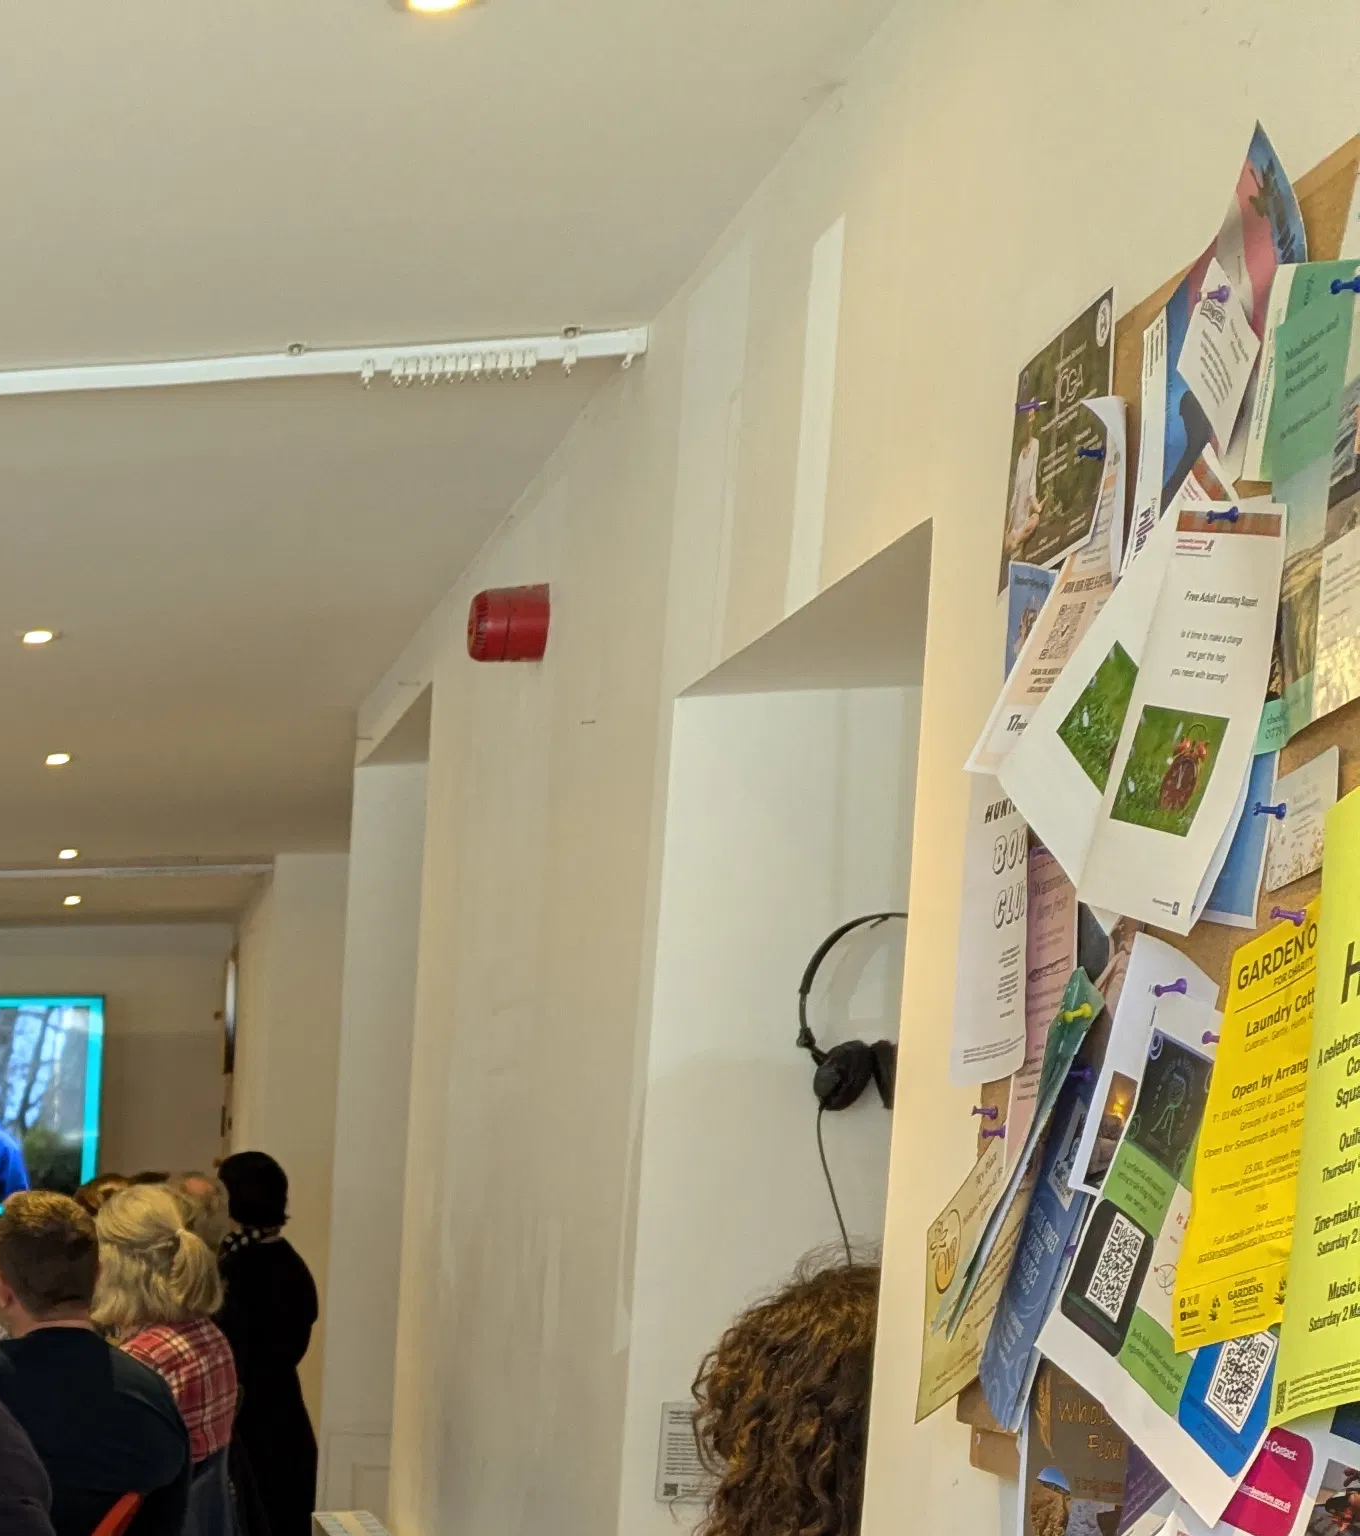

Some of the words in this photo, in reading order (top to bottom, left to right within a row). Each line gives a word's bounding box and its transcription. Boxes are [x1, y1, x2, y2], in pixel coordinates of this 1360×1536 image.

[1236, 930, 1306, 991] GARDEN
[1273, 974, 1288, 988] FOR
[1288, 953, 1315, 981] CHARITY
[1245, 1001, 1294, 1038] Laundry
[1231, 1080, 1259, 1101] Open
[1260, 1073, 1275, 1089] by
[1239, 1116, 1262, 1132] Groups
[1203, 1147, 1222, 1159] Open
[1223, 1142, 1234, 1154] for
[1234, 1130, 1269, 1151] Snowdrops
[1269, 1122, 1289, 1139] during
[1322, 1158, 1357, 1184] Thursday
[1316, 1232, 1351, 1258] Saturday
[1350, 1227, 1359, 1245] 2
[1227, 1281, 1265, 1301] GARDENS
[1232, 1294, 1259, 1309] Scheme
[1327, 1276, 1357, 1302] Music
[1308, 1309, 1342, 1333] Saturday
[1341, 1305, 1349, 1322] 2
